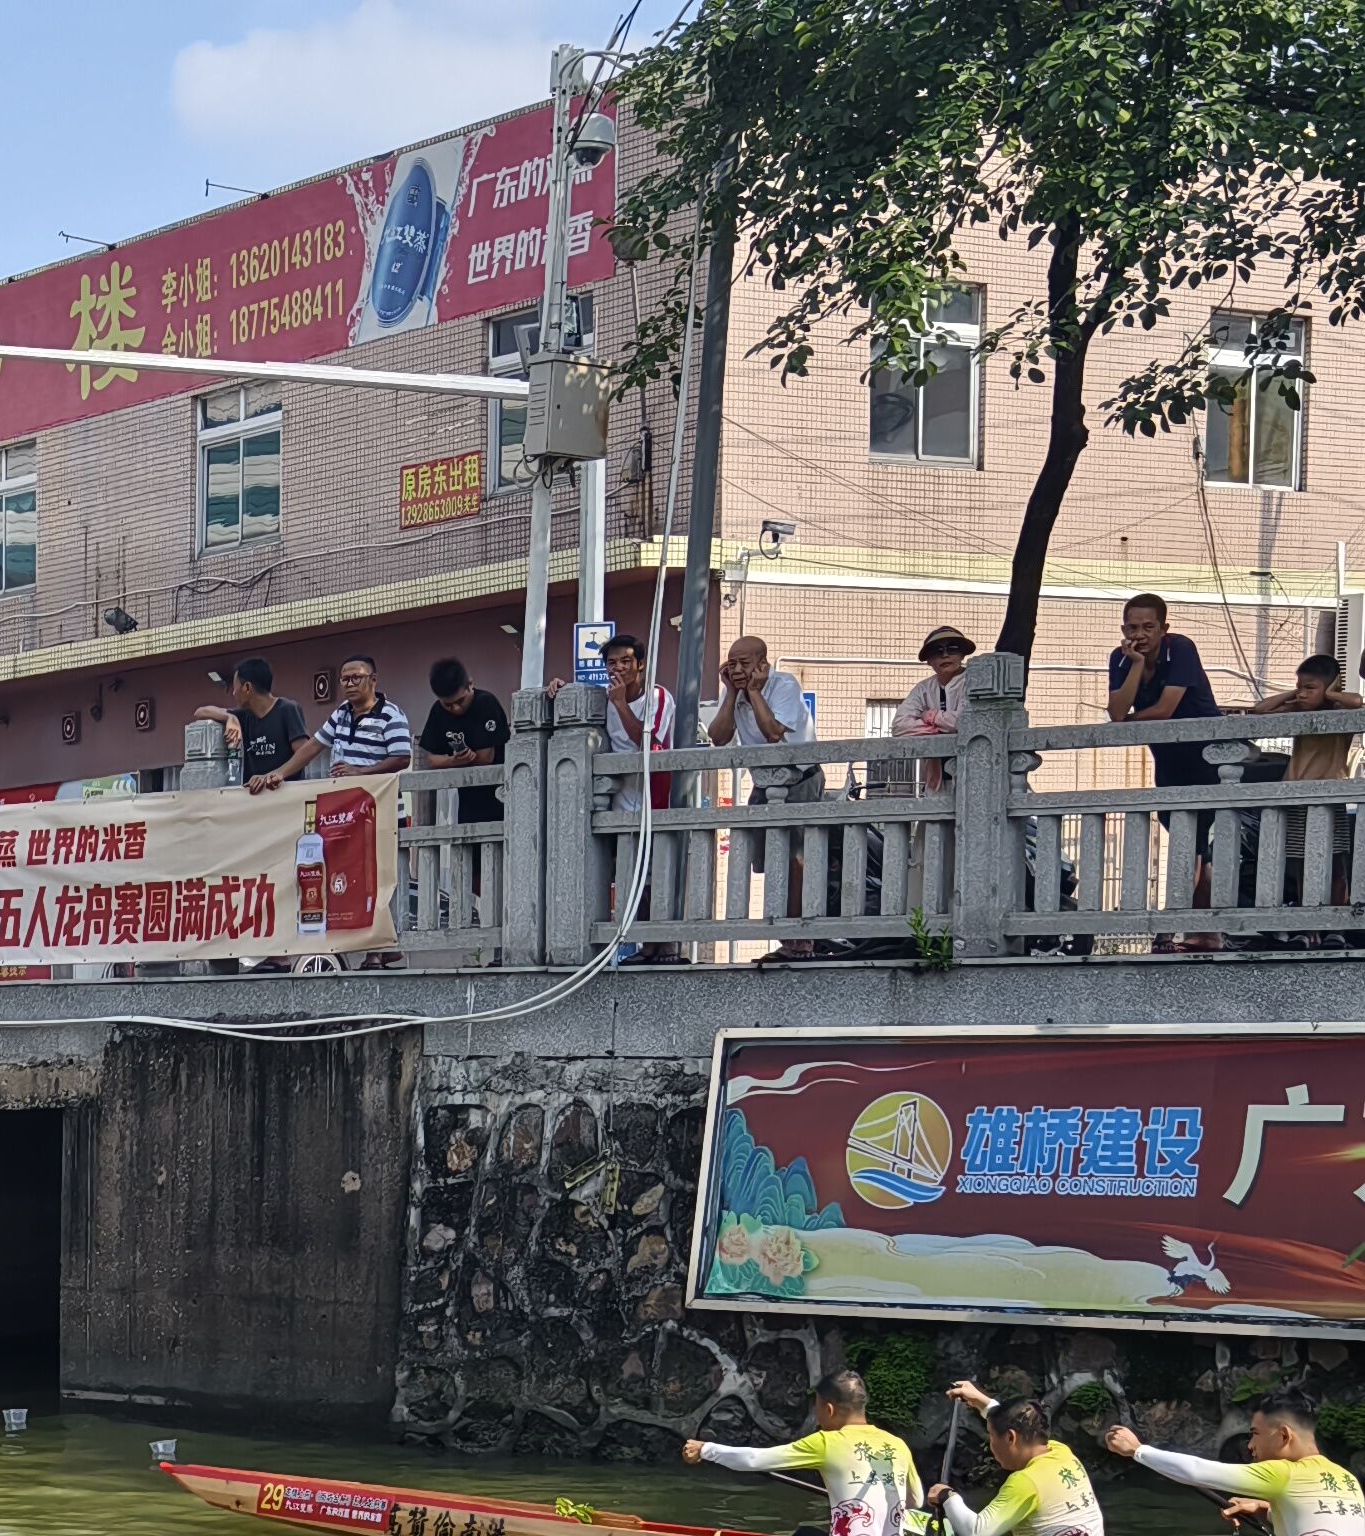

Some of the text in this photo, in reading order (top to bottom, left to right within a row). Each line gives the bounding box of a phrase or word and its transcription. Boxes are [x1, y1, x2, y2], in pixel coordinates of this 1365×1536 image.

[229, 219, 346, 290] 13620143183
[229, 279, 345, 347] 18775488411
[26, 820, 147, 866] 世界的米香
[959, 1105, 1204, 1178] 雄桥建设
[1222, 1083, 1365, 1206] 广
[955, 1174, 1198, 1199] XIONGQIAO CONSTRUCTION
[262, 1482, 285, 1512] 29
